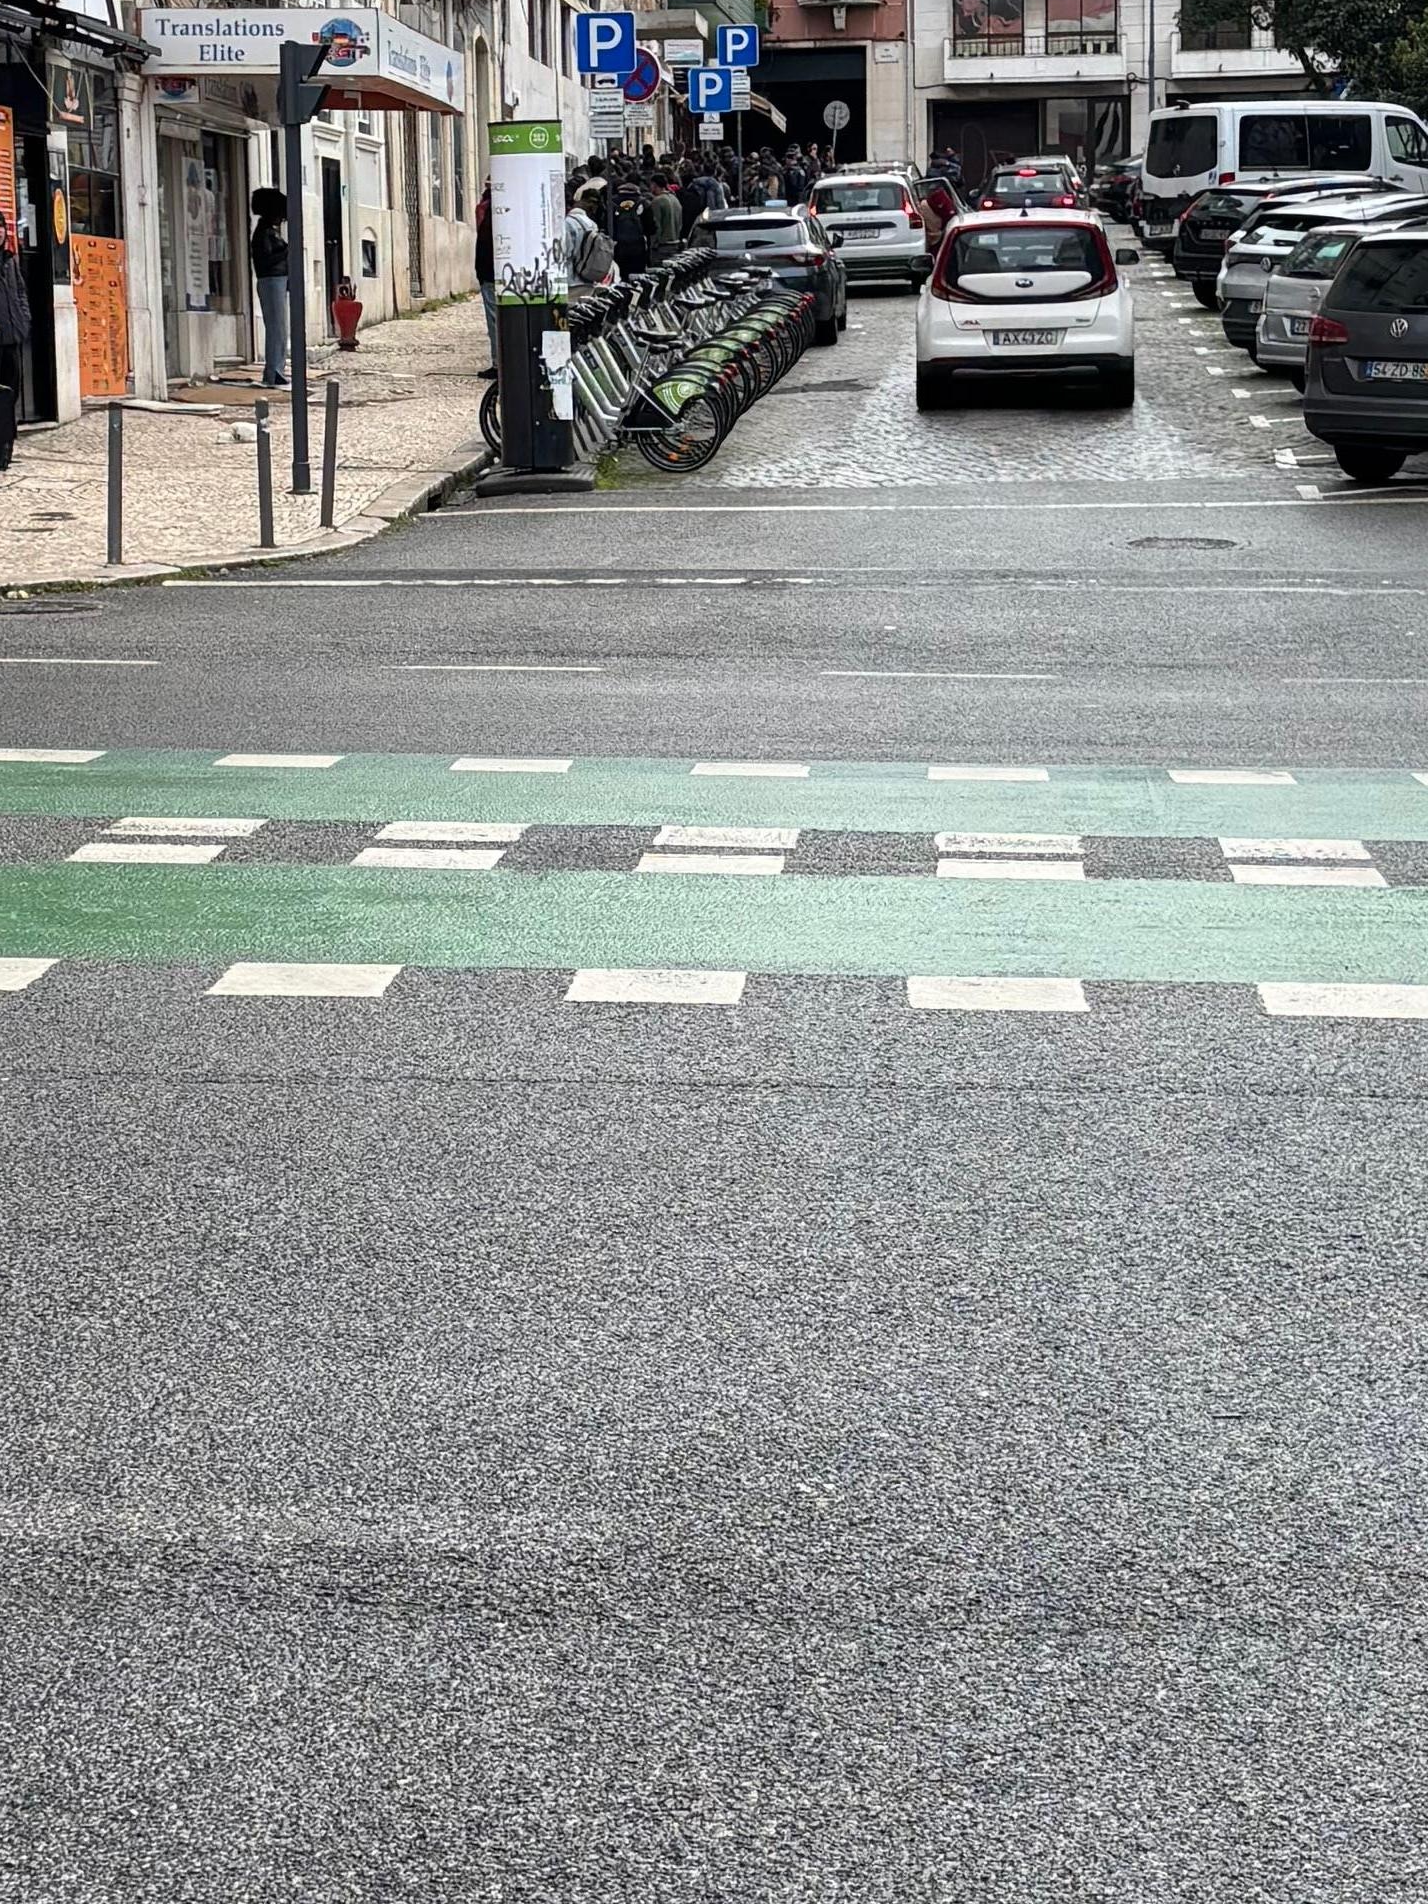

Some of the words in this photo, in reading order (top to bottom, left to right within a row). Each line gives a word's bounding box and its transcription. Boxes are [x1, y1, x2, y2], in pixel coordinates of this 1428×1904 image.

[155, 17, 285, 38] Translations
[588, 17, 623, 68] P
[198, 43, 246, 62] Elite
[726, 28, 750, 63] P
[698, 71, 724, 108] P
